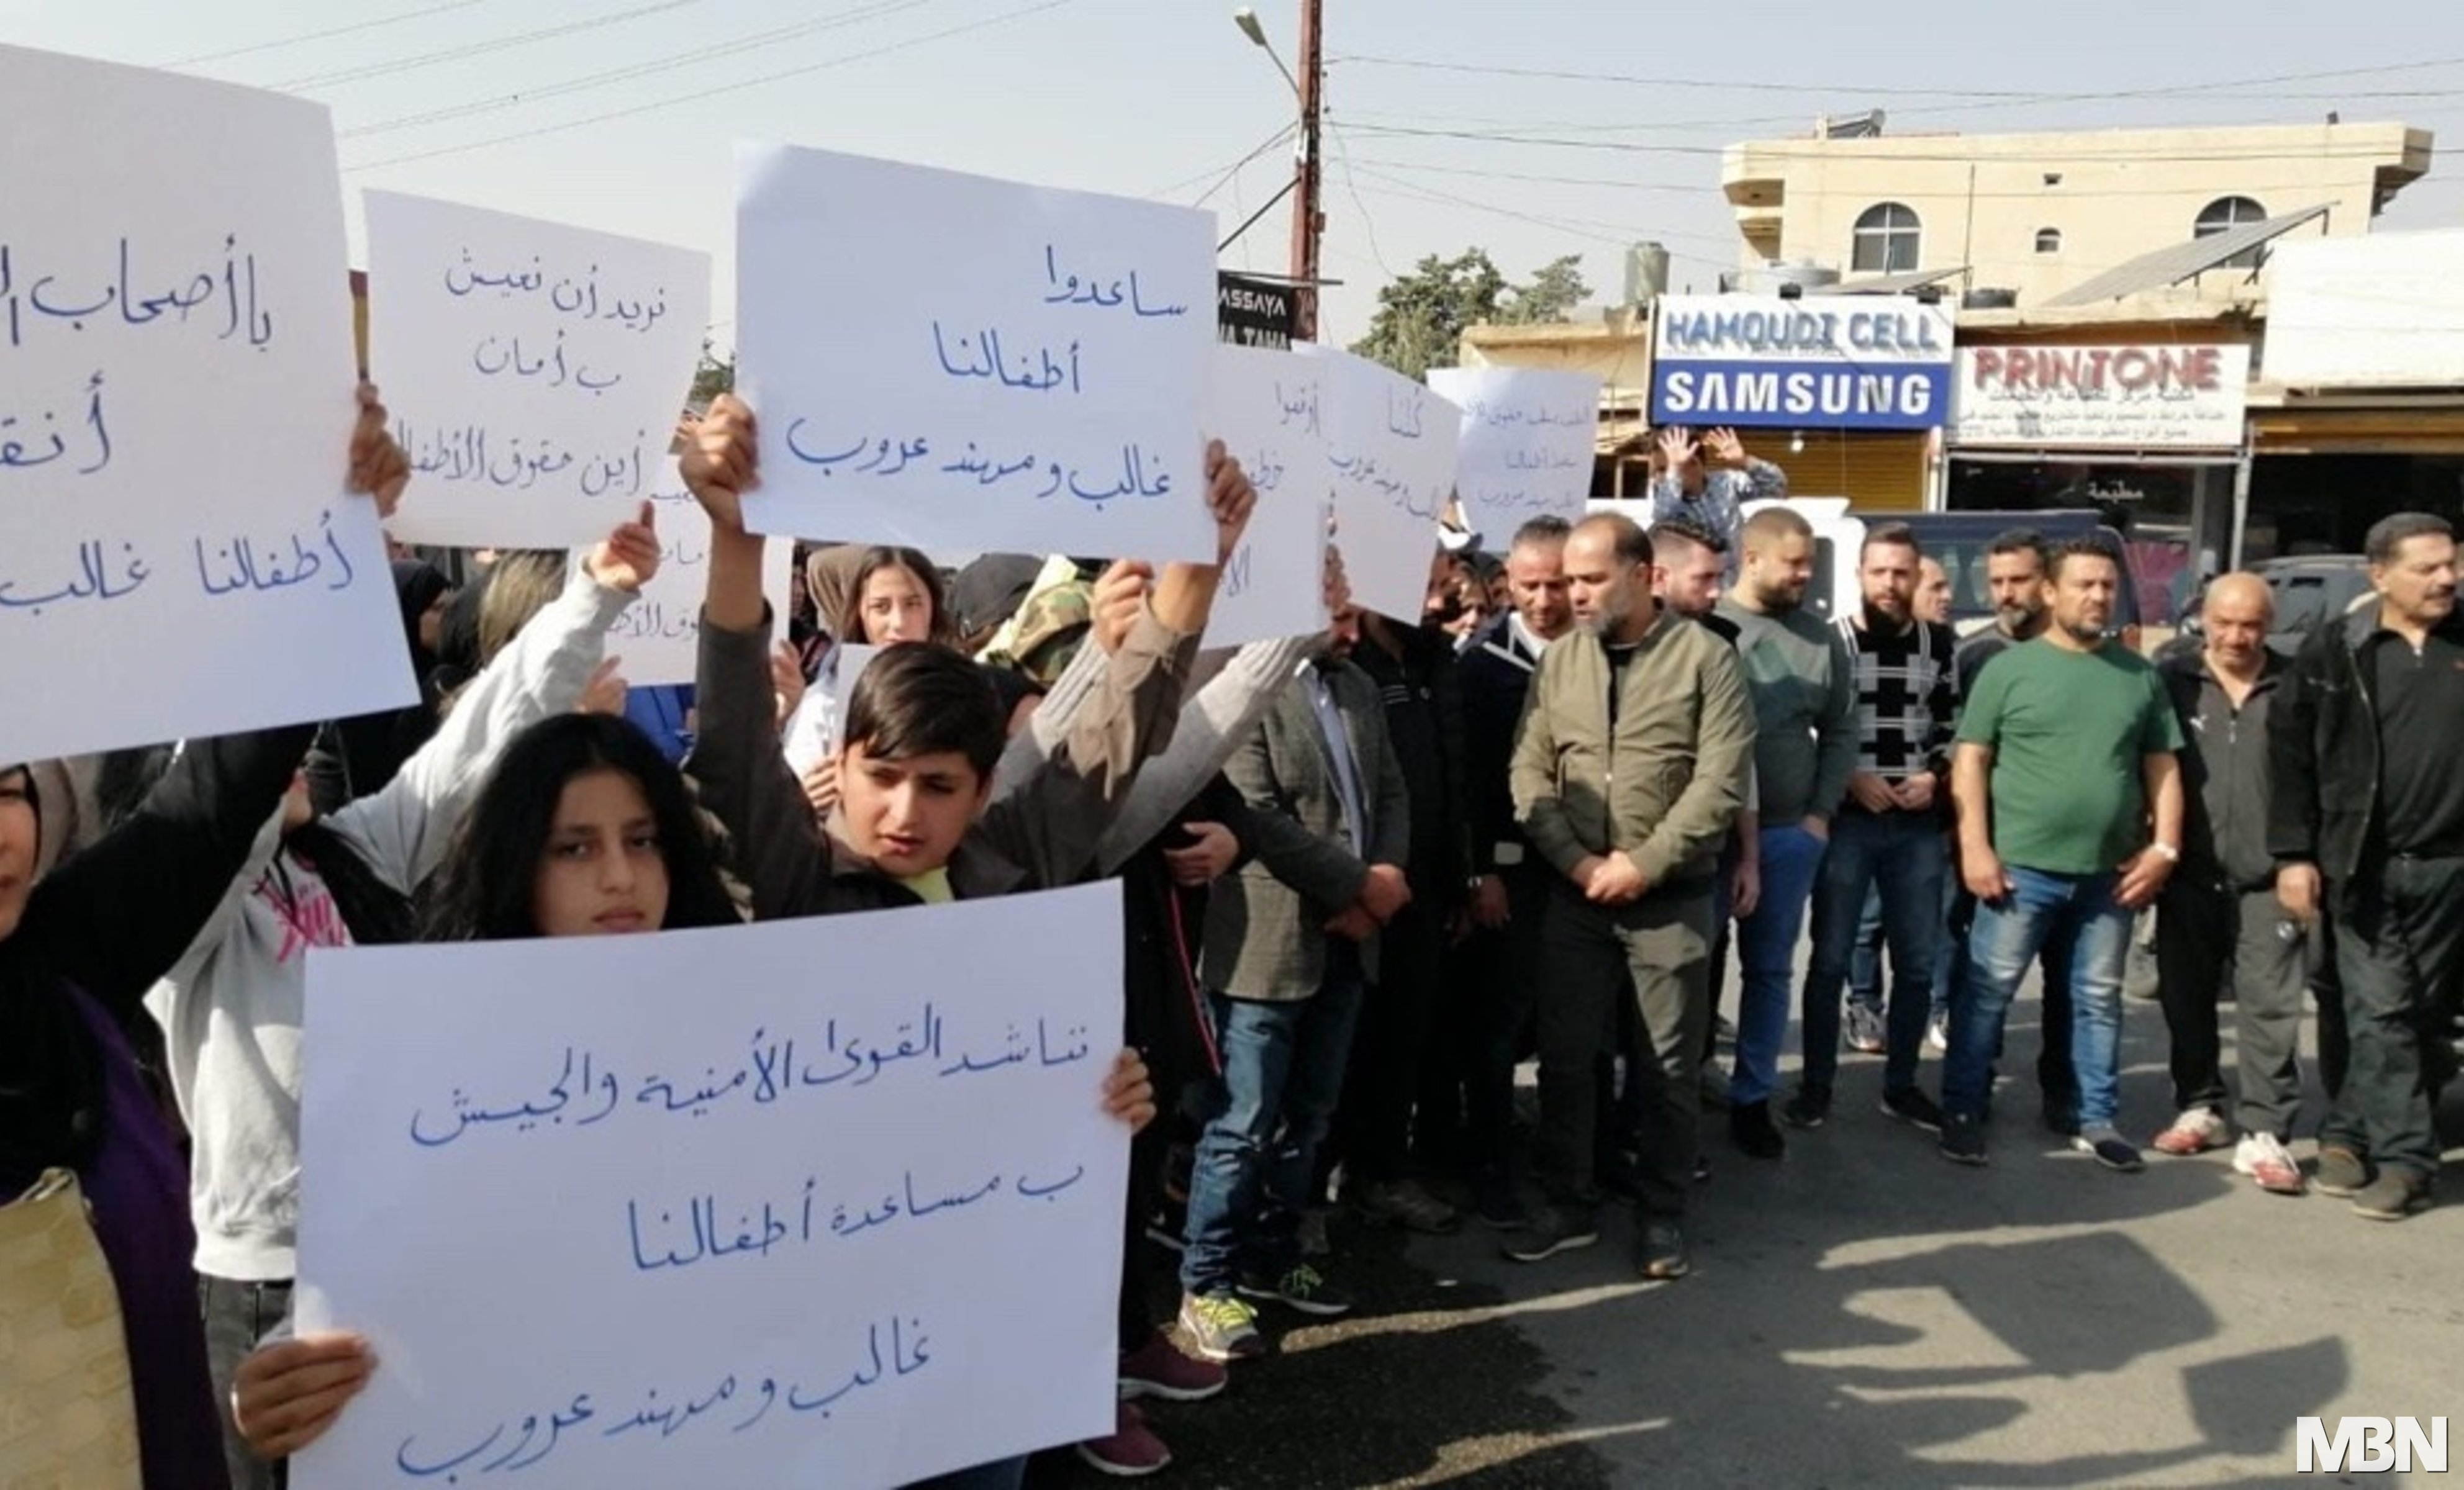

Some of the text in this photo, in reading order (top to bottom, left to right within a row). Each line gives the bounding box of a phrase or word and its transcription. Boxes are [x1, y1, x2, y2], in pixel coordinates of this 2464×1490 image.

[551, 263, 597, 320] أن
[1045, 245, 1188, 317] ساعدوا
[933, 320, 1080, 394] أطفالنا
[1666, 311, 1940, 351] HAMOUDI CELL
[1665, 371, 1932, 415] SAMSUNG
[1975, 348, 2222, 391] PRINTONE
[489, 438, 574, 490] حقوق
[1068, 443, 1172, 512] غالب
[196, 509, 354, 596] أطفالنا
[409, 1046, 619, 1147] والجيش
[635, 1027, 793, 1117] الأمنية
[628, 1175, 816, 1270] أطفالنا
[830, 1170, 1002, 1235] مساعدة
[787, 1315, 931, 1420] غالب
